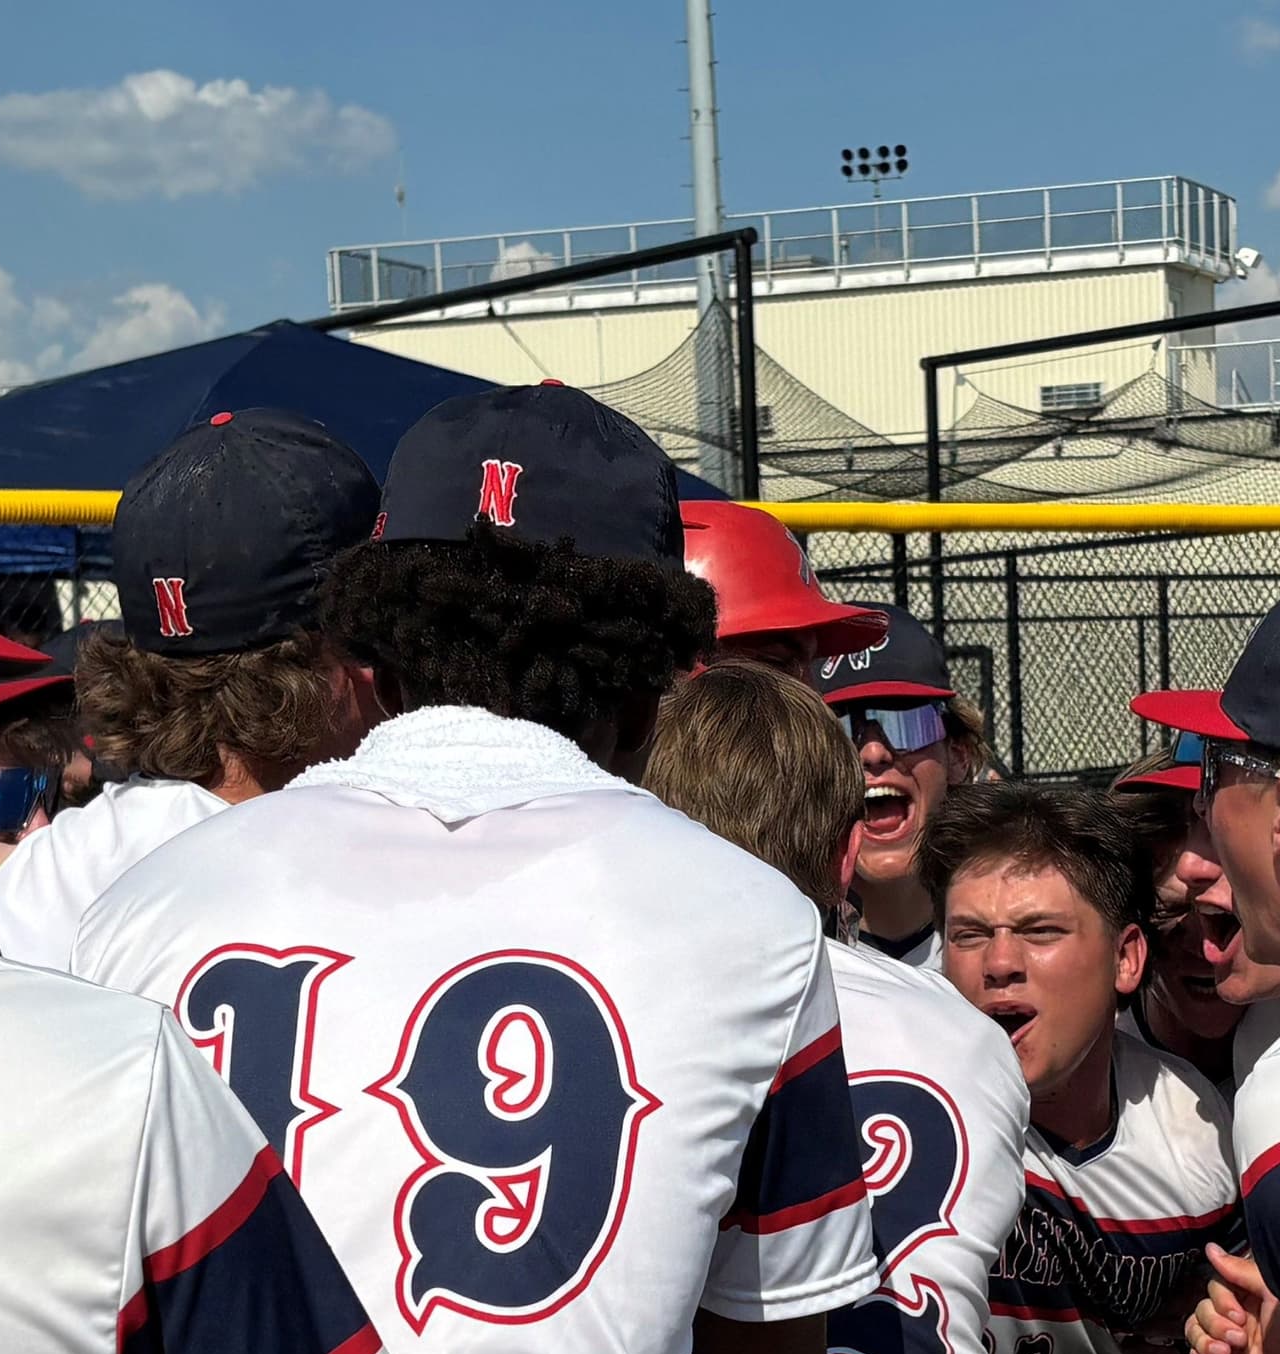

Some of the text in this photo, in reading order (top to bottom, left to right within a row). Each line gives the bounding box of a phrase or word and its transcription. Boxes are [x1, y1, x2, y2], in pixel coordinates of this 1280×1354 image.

[474, 460, 523, 526] N
[153, 577, 193, 637] N
[175, 943, 663, 1336] 19
